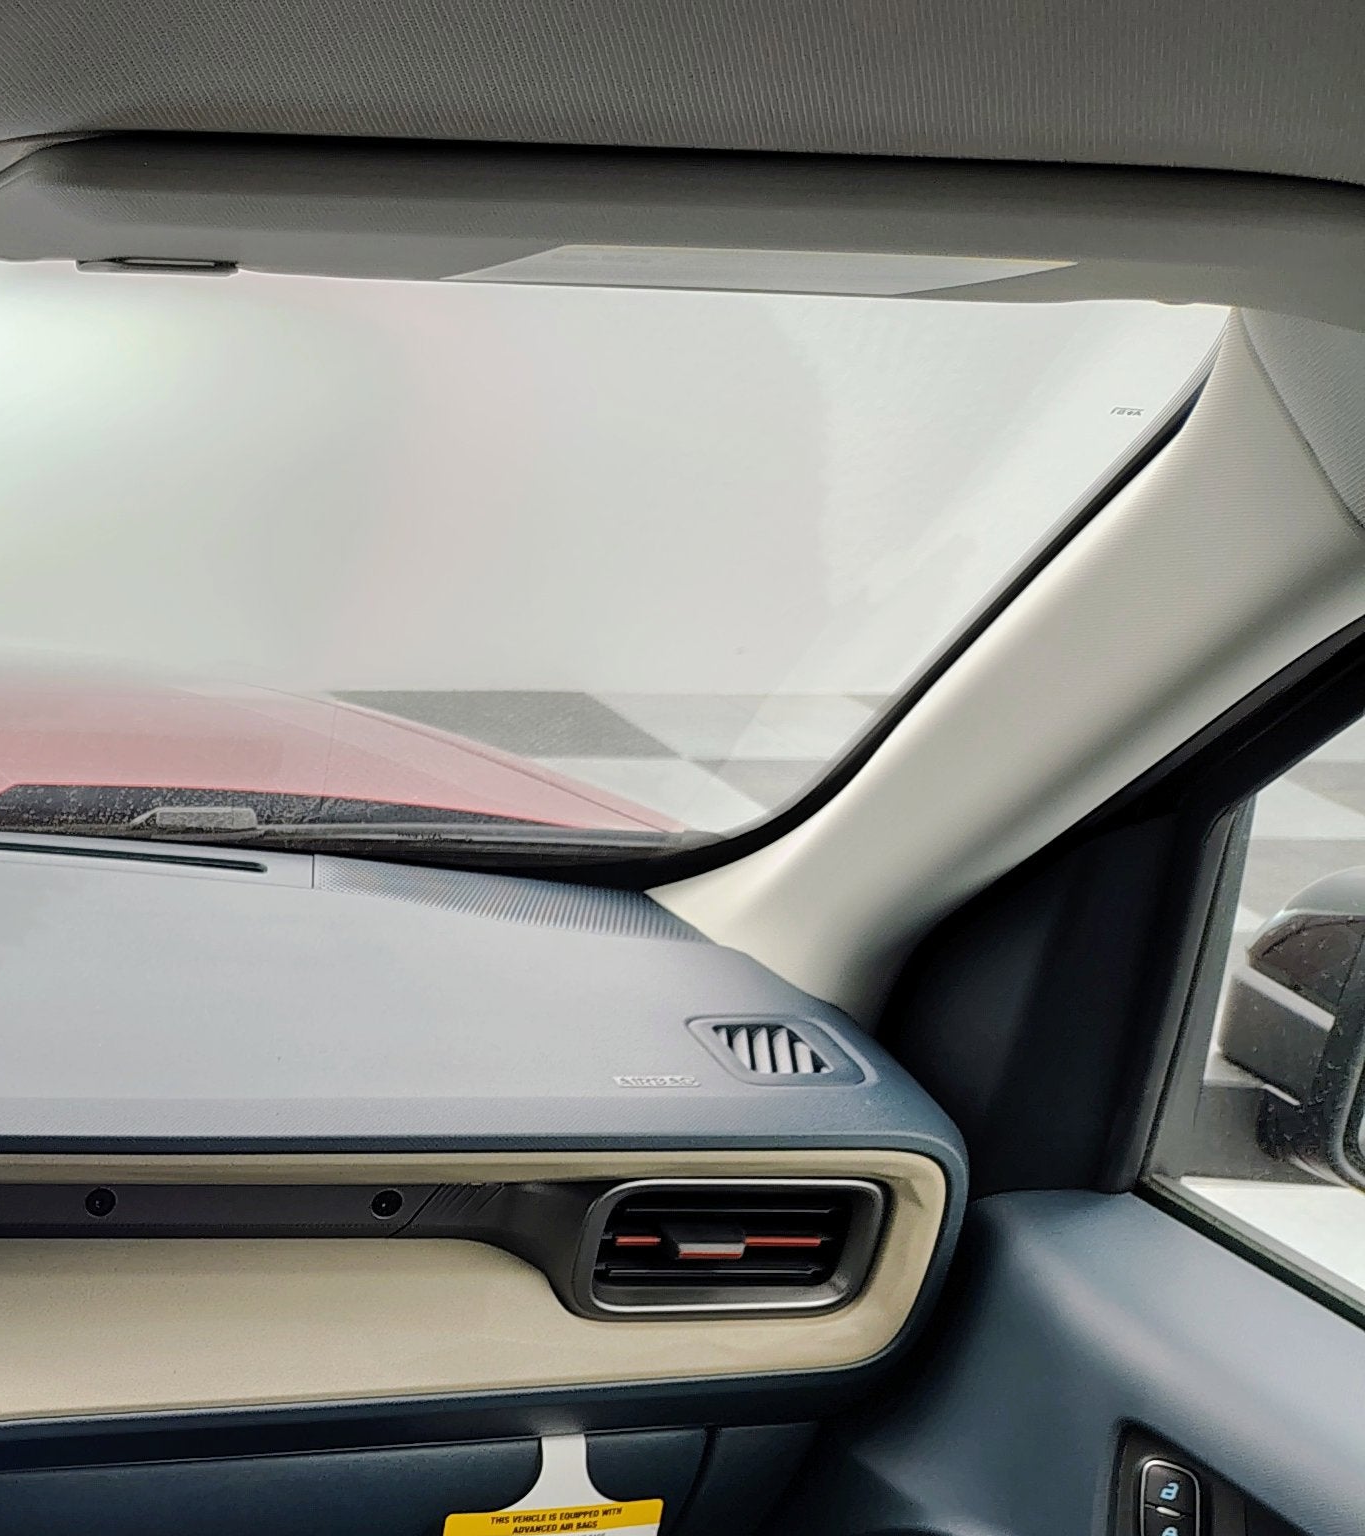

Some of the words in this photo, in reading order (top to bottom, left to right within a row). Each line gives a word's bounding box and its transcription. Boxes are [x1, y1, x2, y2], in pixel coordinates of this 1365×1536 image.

[490, 1516, 510, 1525] THIS
[512, 1514, 547, 1524] VEHICLE
[548, 1513, 557, 1521] IS
[559, 1510, 600, 1520] EQUIPPED
[601, 1507, 623, 1516] WITH
[512, 1524, 558, 1535] ADVANCED
[559, 1522, 574, 1531] AIR
[575, 1520, 598, 1530] BAGS
